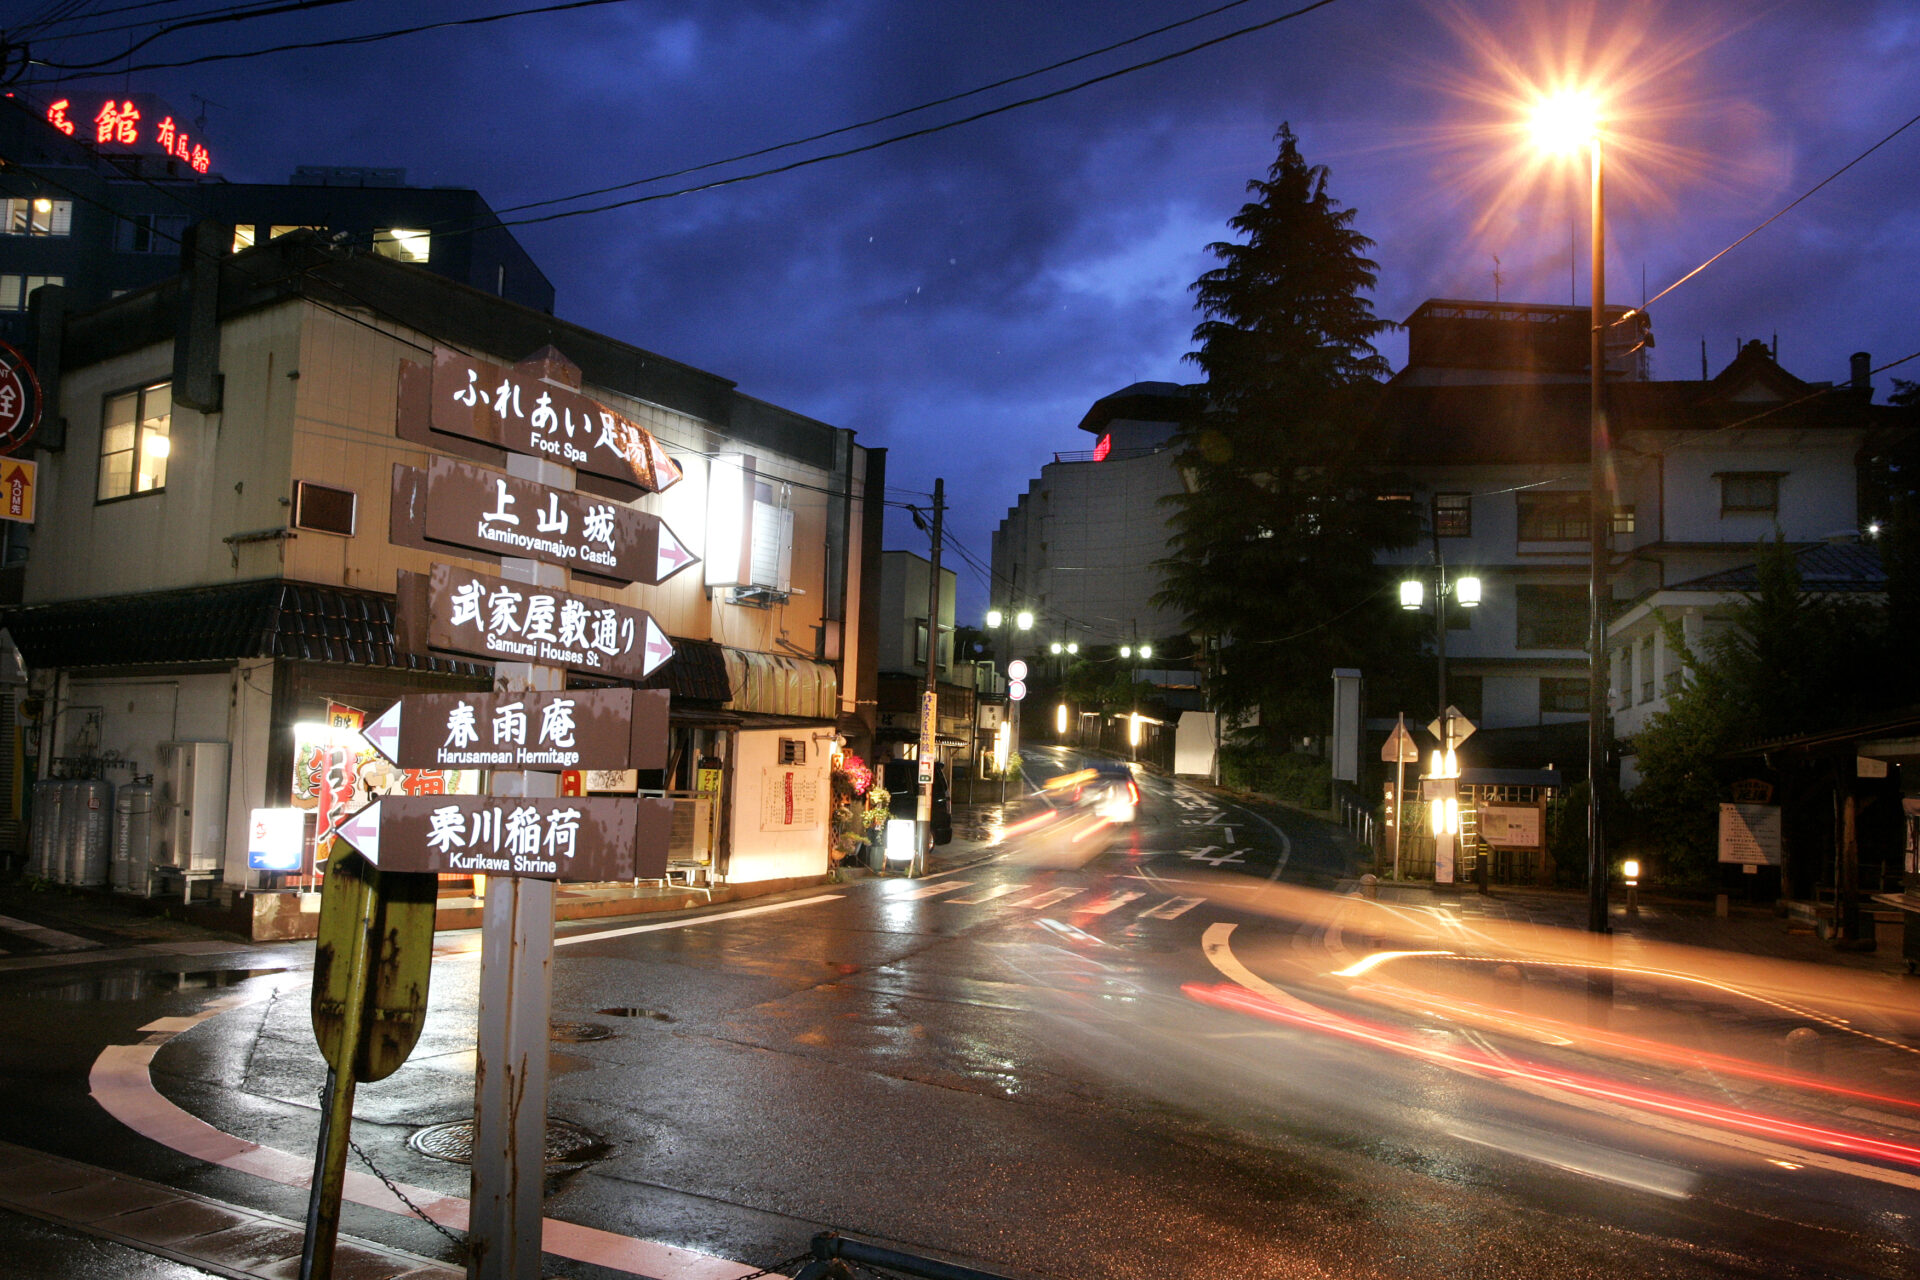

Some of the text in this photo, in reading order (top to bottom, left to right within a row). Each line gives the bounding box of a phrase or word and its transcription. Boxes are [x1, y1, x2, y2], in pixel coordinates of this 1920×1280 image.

[156, 116, 211, 174] 有馬館
[453, 368, 646, 469] ふれあい足湯
[530, 432, 588, 463] Foot Spa
[482, 478, 616, 552] 上山城
[478, 521, 617, 567] Kaminoyamajyo Castle
[450, 579, 635, 657] 武家屋敷通り
[486, 634, 602, 668] Samurai Houses St.
[443, 697, 577, 748] 春雨庵
[437, 748, 580, 767] Harusamean Hermitage
[426, 804, 582, 858] 栗川稲荷
[449, 852, 557, 873] Kurikawa Shrine
